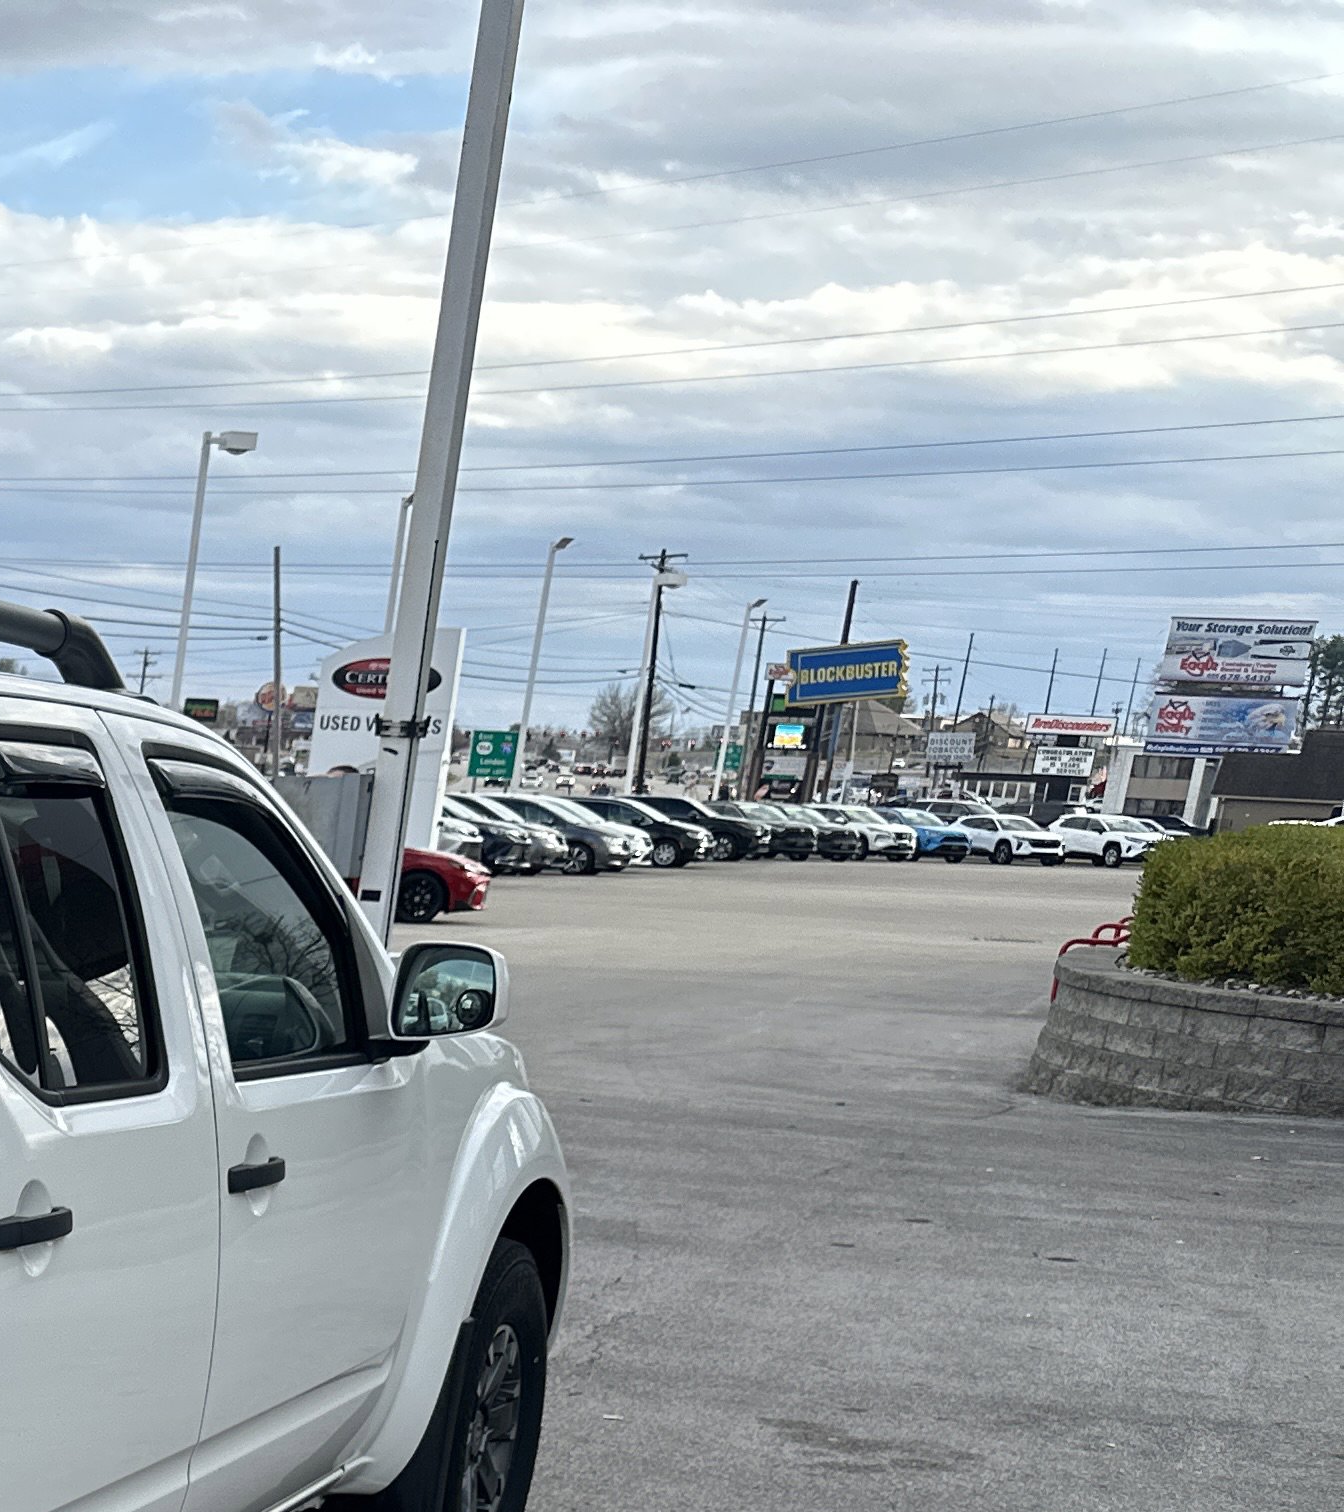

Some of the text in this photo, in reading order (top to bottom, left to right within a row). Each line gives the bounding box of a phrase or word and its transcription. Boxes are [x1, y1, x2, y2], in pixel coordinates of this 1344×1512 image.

[1176, 620, 1313, 636] Your Storage Solution!
[800, 660, 898, 685] BLOCKBUSTER
[1179, 655, 1219, 677] Eagle
[1157, 703, 1196, 724] Eagle
[320, 714, 361, 731] USED
[928, 746, 966, 754] TOBACCO
[930, 738, 973, 746] DISCOUNT
